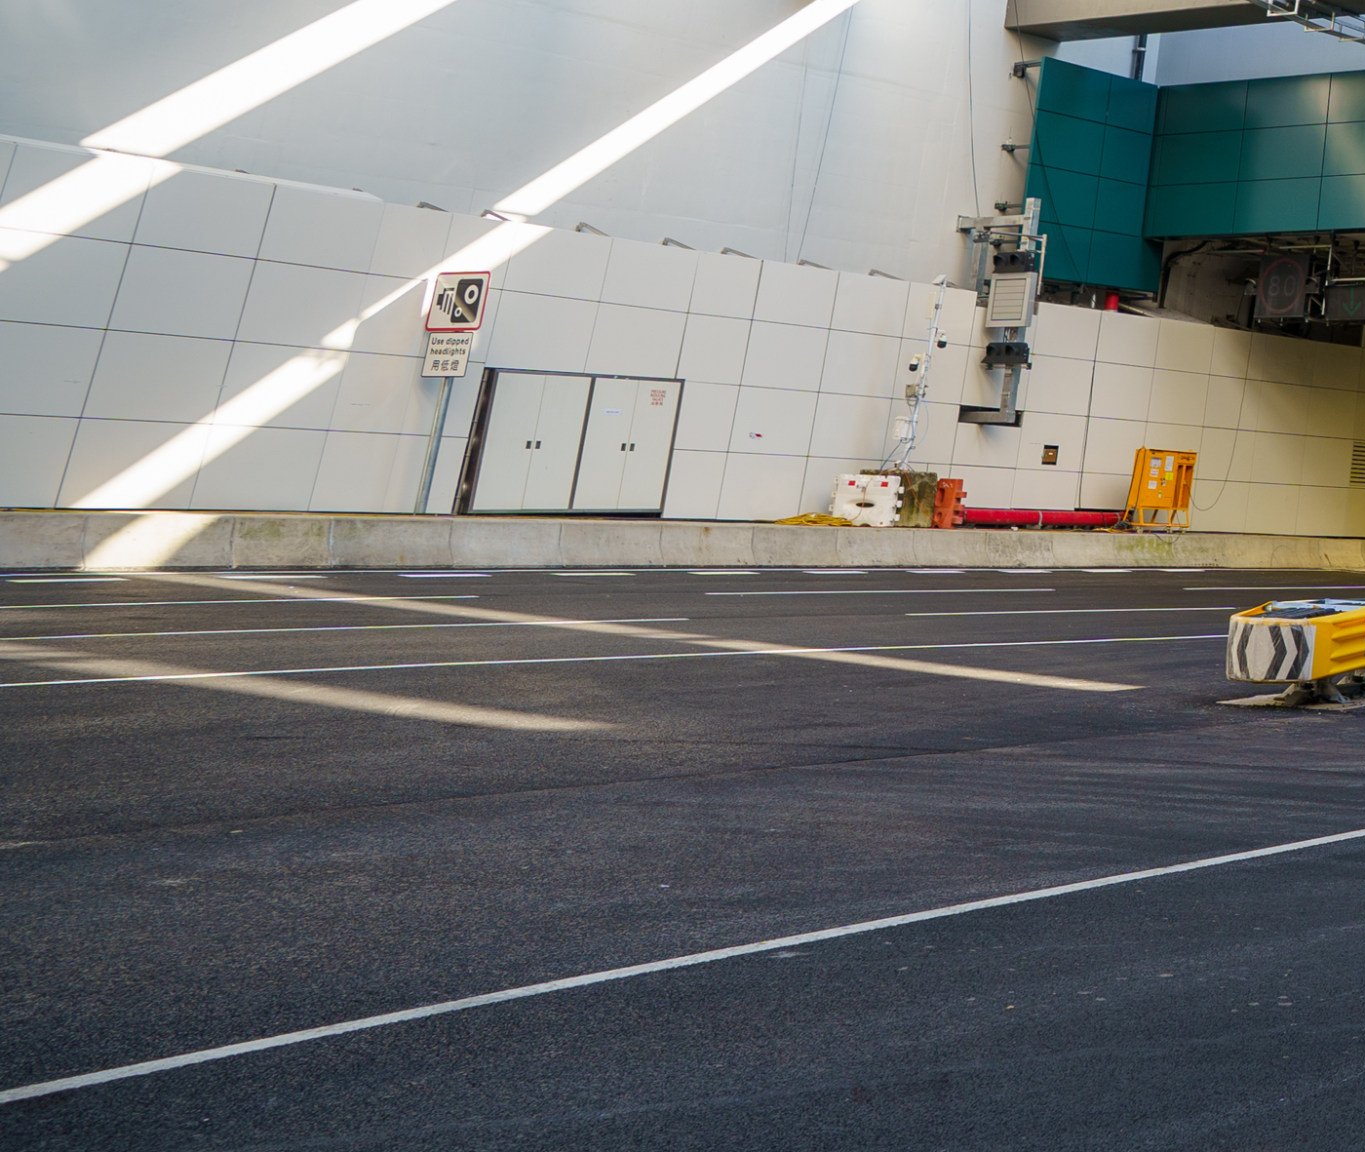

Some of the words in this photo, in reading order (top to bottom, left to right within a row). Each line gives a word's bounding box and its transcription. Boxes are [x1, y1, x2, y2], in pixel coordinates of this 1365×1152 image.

[1267, 274, 1296, 297] 80
[431, 337, 445, 346] Use
[446, 337, 470, 346] dipped
[430, 347, 466, 356] headlights
